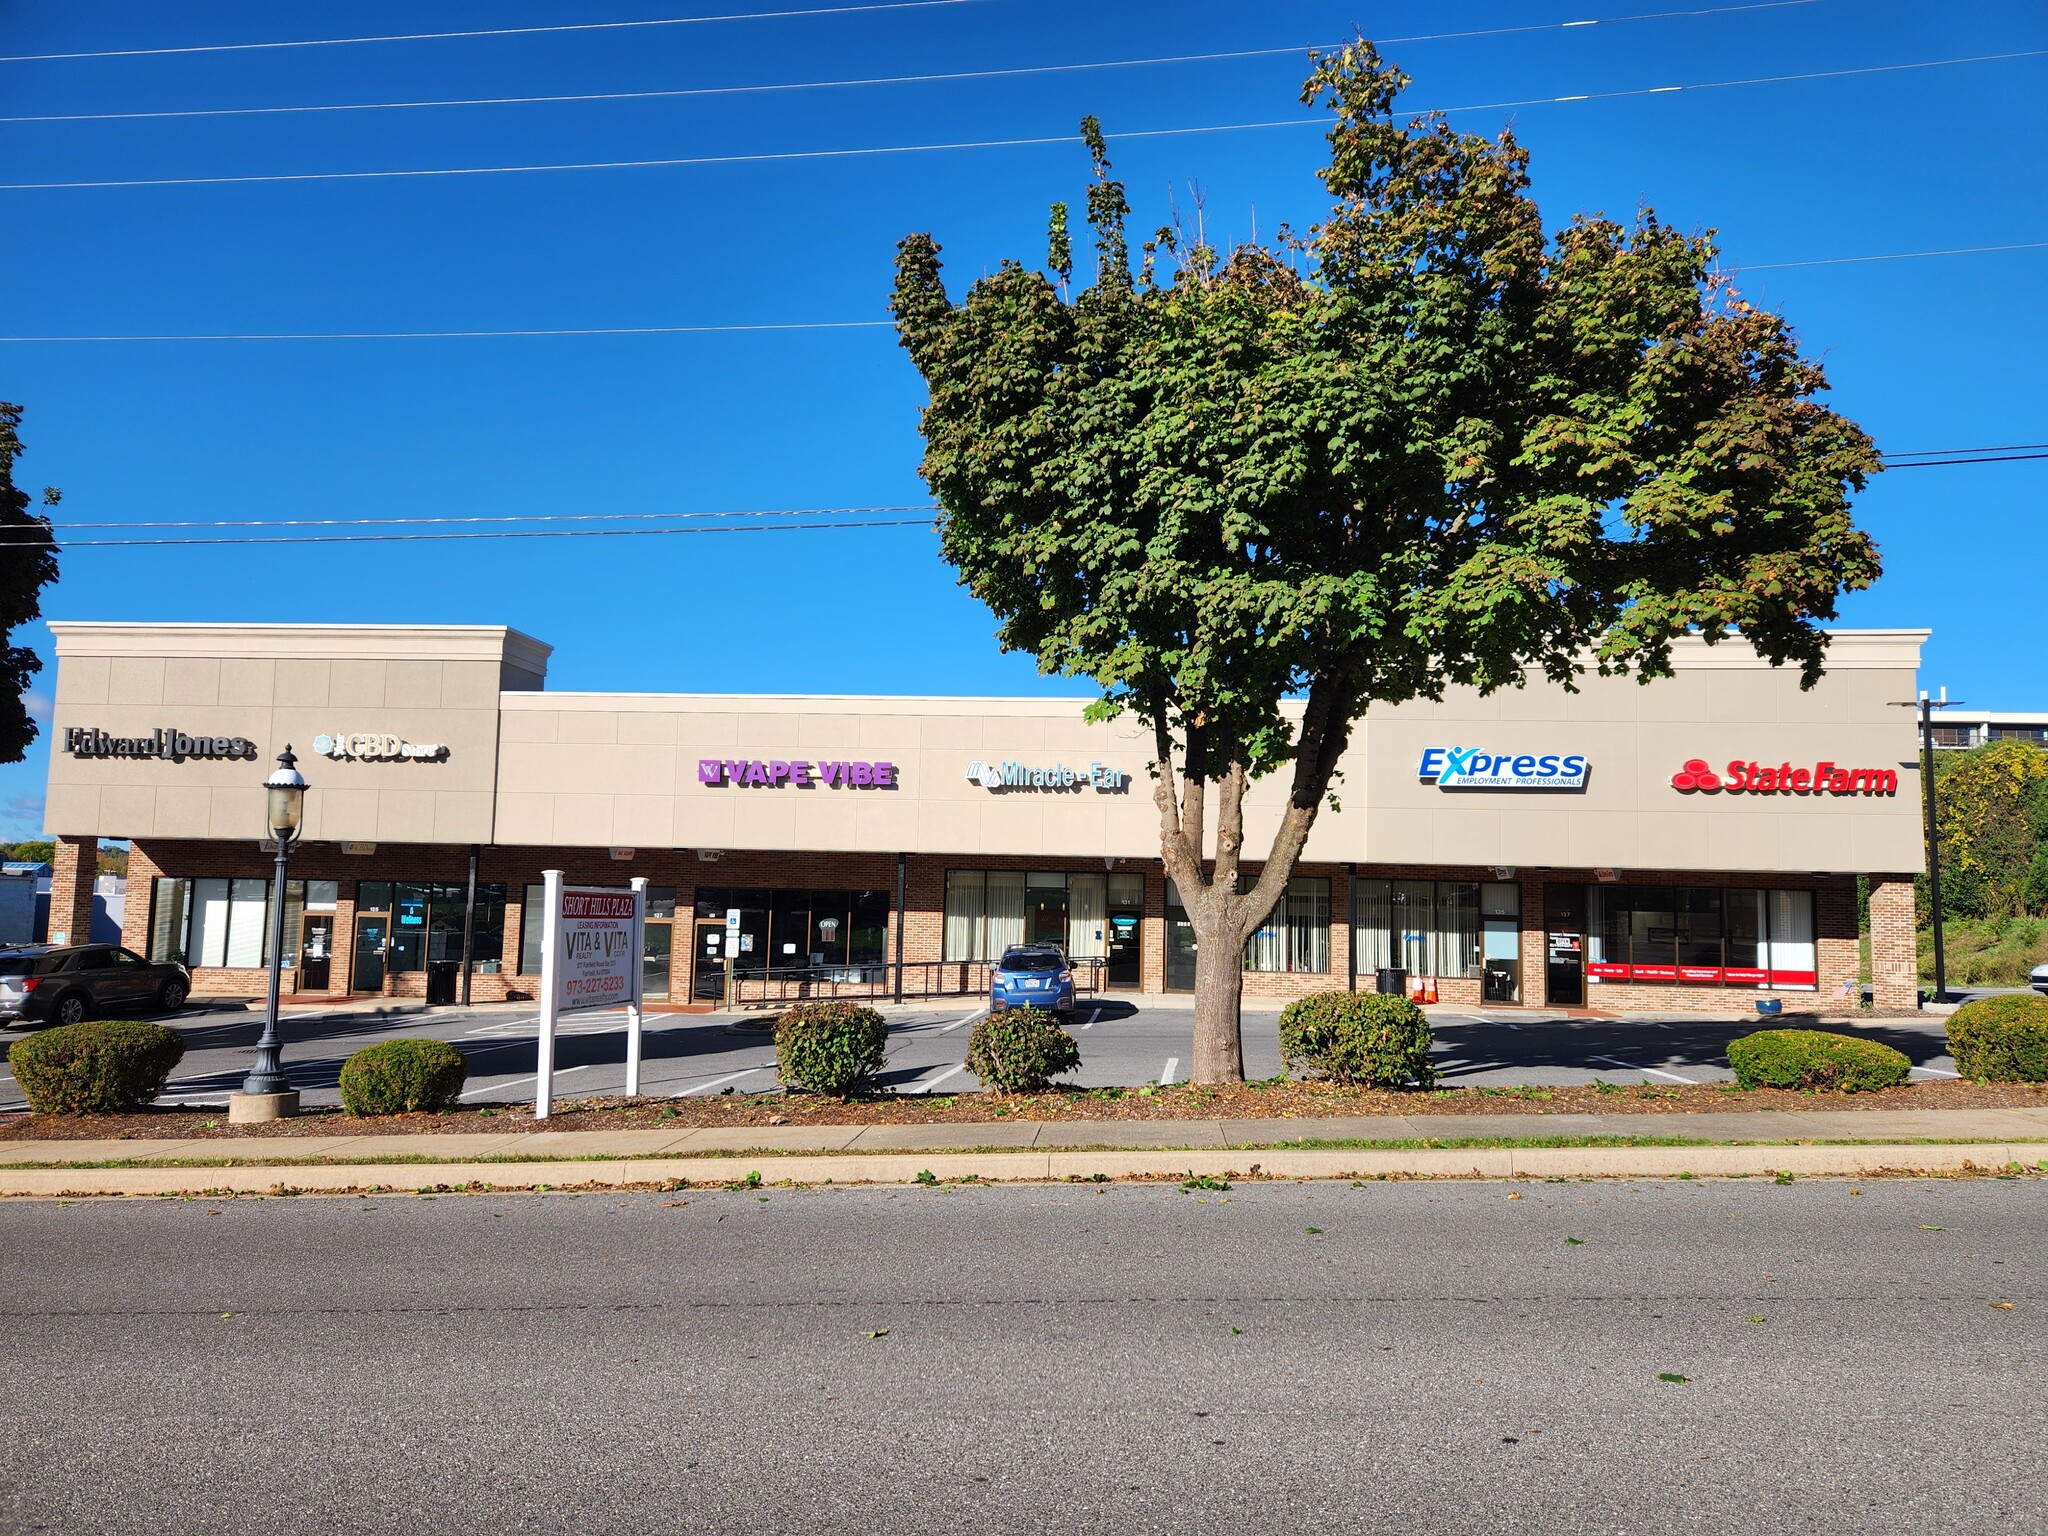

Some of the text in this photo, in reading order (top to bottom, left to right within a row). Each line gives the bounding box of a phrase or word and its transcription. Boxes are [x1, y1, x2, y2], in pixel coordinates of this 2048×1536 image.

[62, 727, 248, 758] Edward Jones
[346, 733, 401, 757] CBD
[724, 760, 892, 785] VAPE VIBE
[1456, 777, 1513, 785] EMPLOYMENT
[1724, 760, 1897, 792] State Farm
[562, 896, 633, 916] SHORT HILLS PLAZA
[820, 920, 836, 928] OPEN
[566, 931, 629, 959] VITA & VITA
[576, 952, 593, 960] REALTY
[567, 976, 624, 996] 973-227-5233
